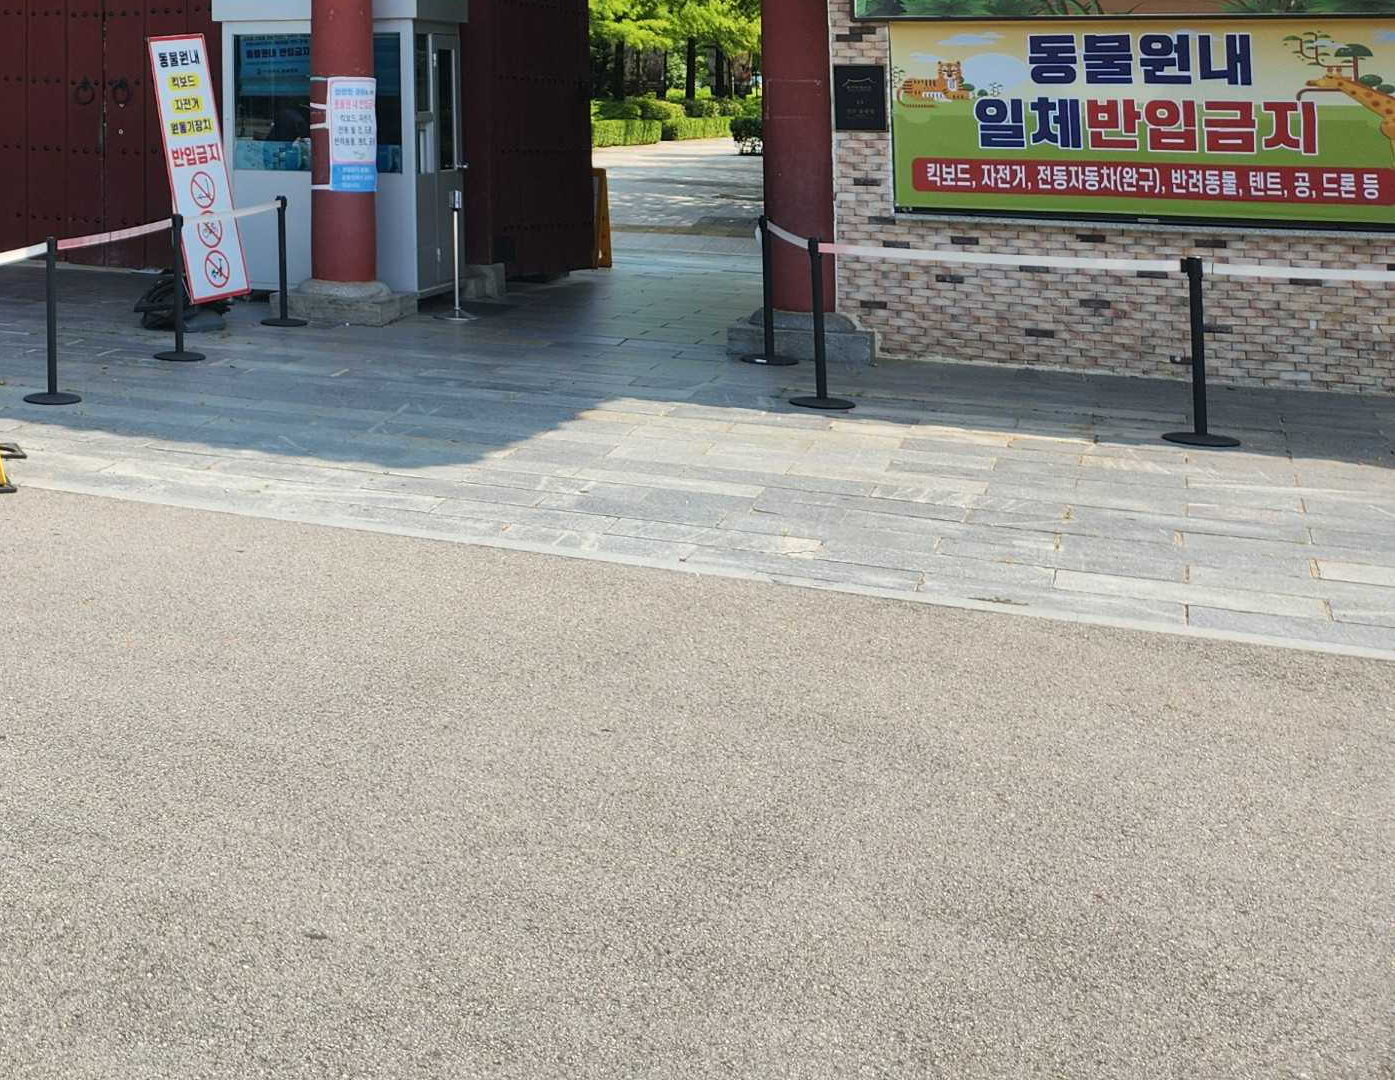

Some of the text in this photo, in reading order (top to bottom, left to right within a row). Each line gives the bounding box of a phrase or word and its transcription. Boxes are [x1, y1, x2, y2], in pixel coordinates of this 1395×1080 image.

[158, 49, 201, 68] 동물원내
[1027, 32, 1253, 87] 동물원내
[170, 75, 196, 88] 킥보드
[175, 97, 200, 111] 자전거
[170, 118, 212, 135] 원동기장치
[171, 142, 221, 168] 반입금지
[926, 163, 1380, 200] 킥보드, 자전거, 전동자동차(완구), 반려동물, 텐트, 공, 드론 등
